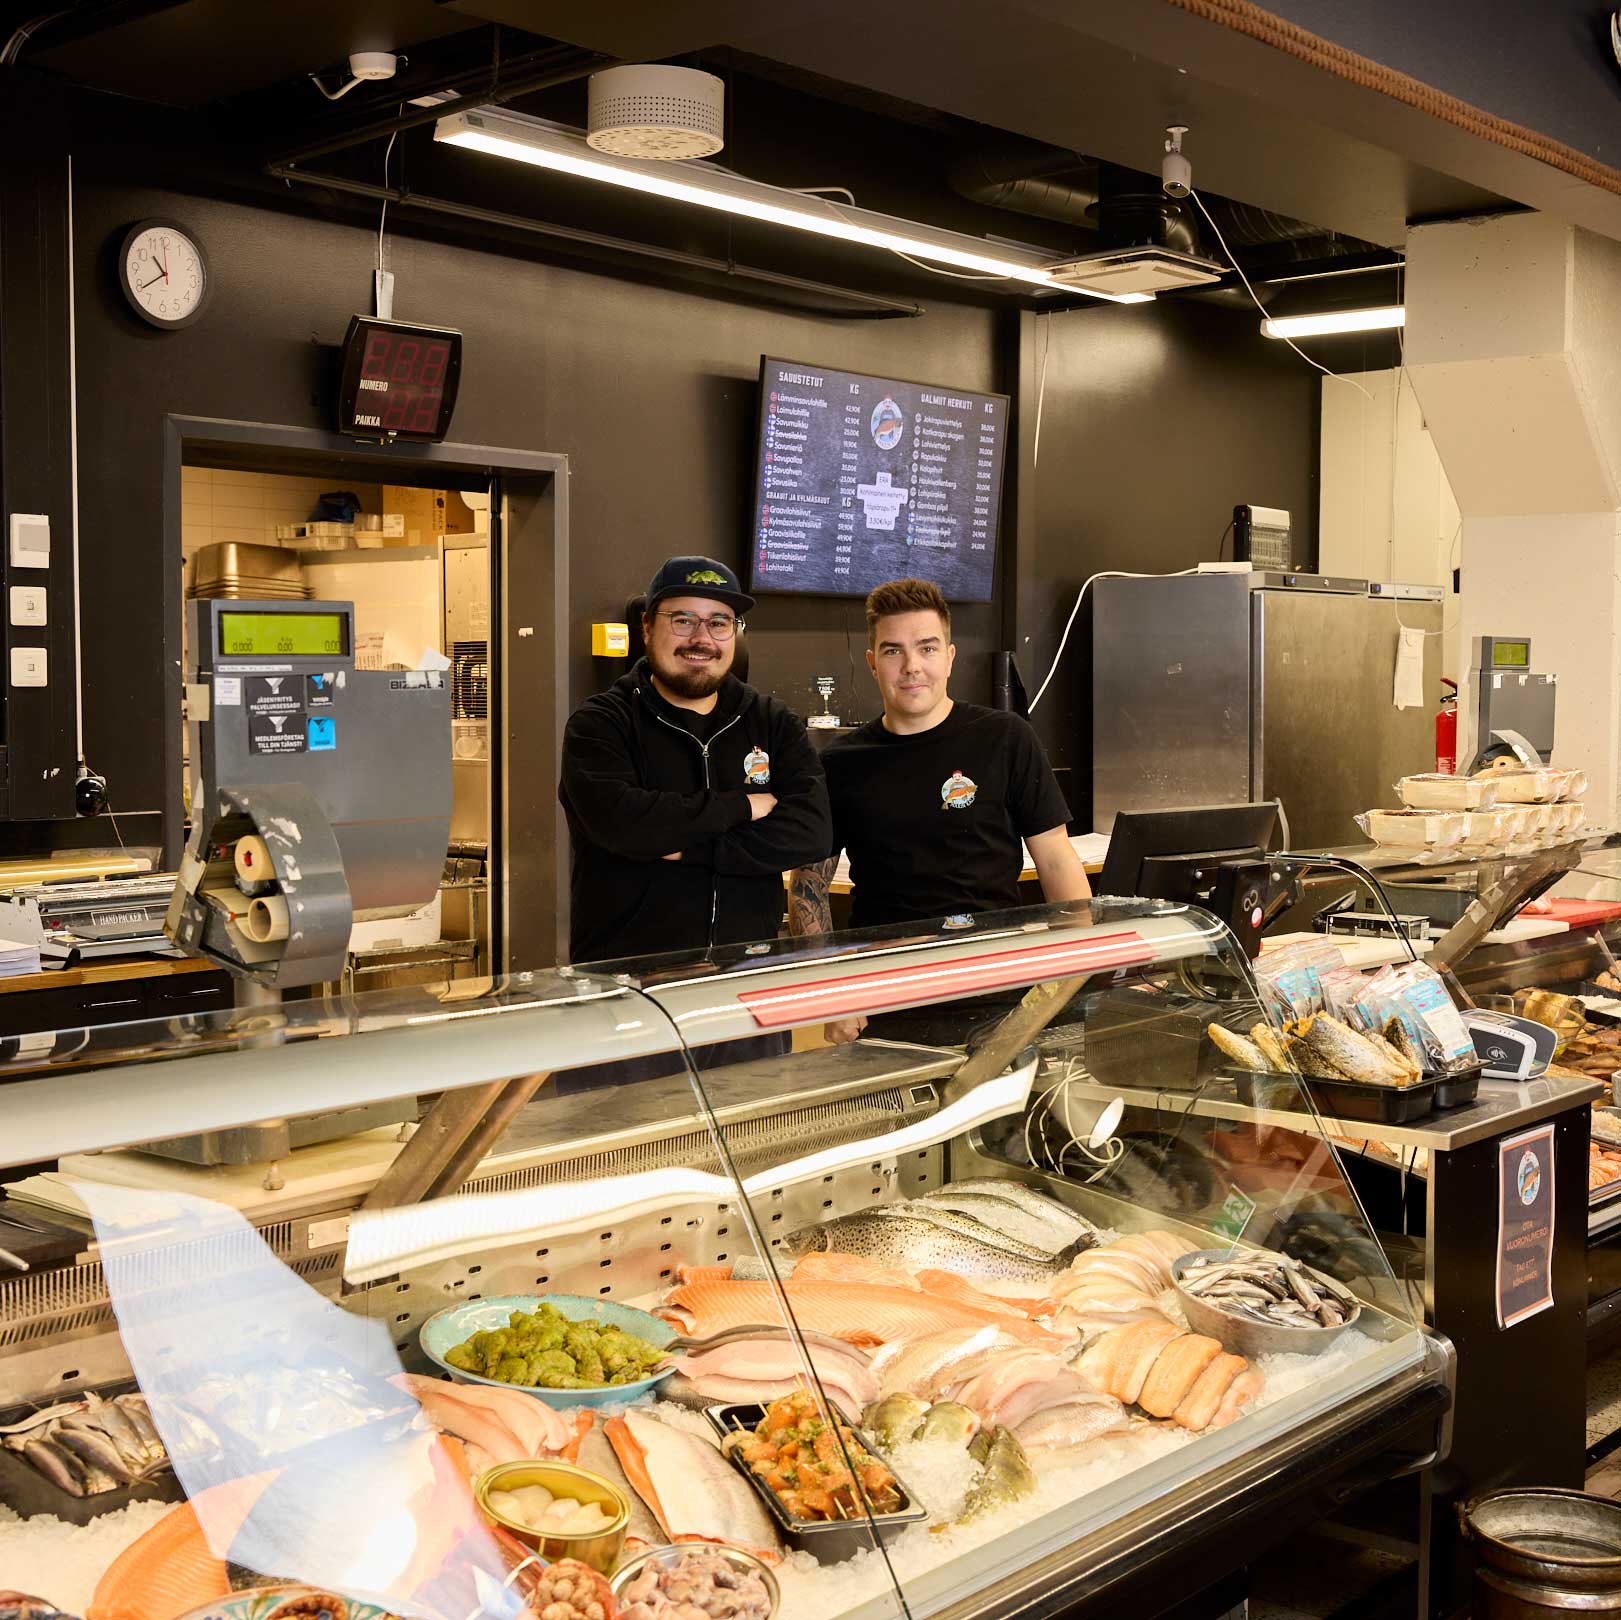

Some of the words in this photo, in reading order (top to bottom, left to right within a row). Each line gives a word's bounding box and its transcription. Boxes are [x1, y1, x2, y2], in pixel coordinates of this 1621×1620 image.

[149, 237, 157, 252] 11
[137, 248, 148, 262] 10
[131, 261, 139, 275] 9
[186, 258, 196, 272] 2
[135, 278, 143, 293] 8
[189, 274, 198, 289] 3
[146, 292, 152, 304] 7
[183, 290, 190, 303] 4
[159, 300, 167, 313] 6
[173, 299, 180, 312] 5
[359, 379, 388, 392] NUMERO
[849, 384, 860, 395] KG
[984, 403, 994, 413] KG
[355, 414, 381, 427] PAIKKA
[841, 496, 852, 508] KG
